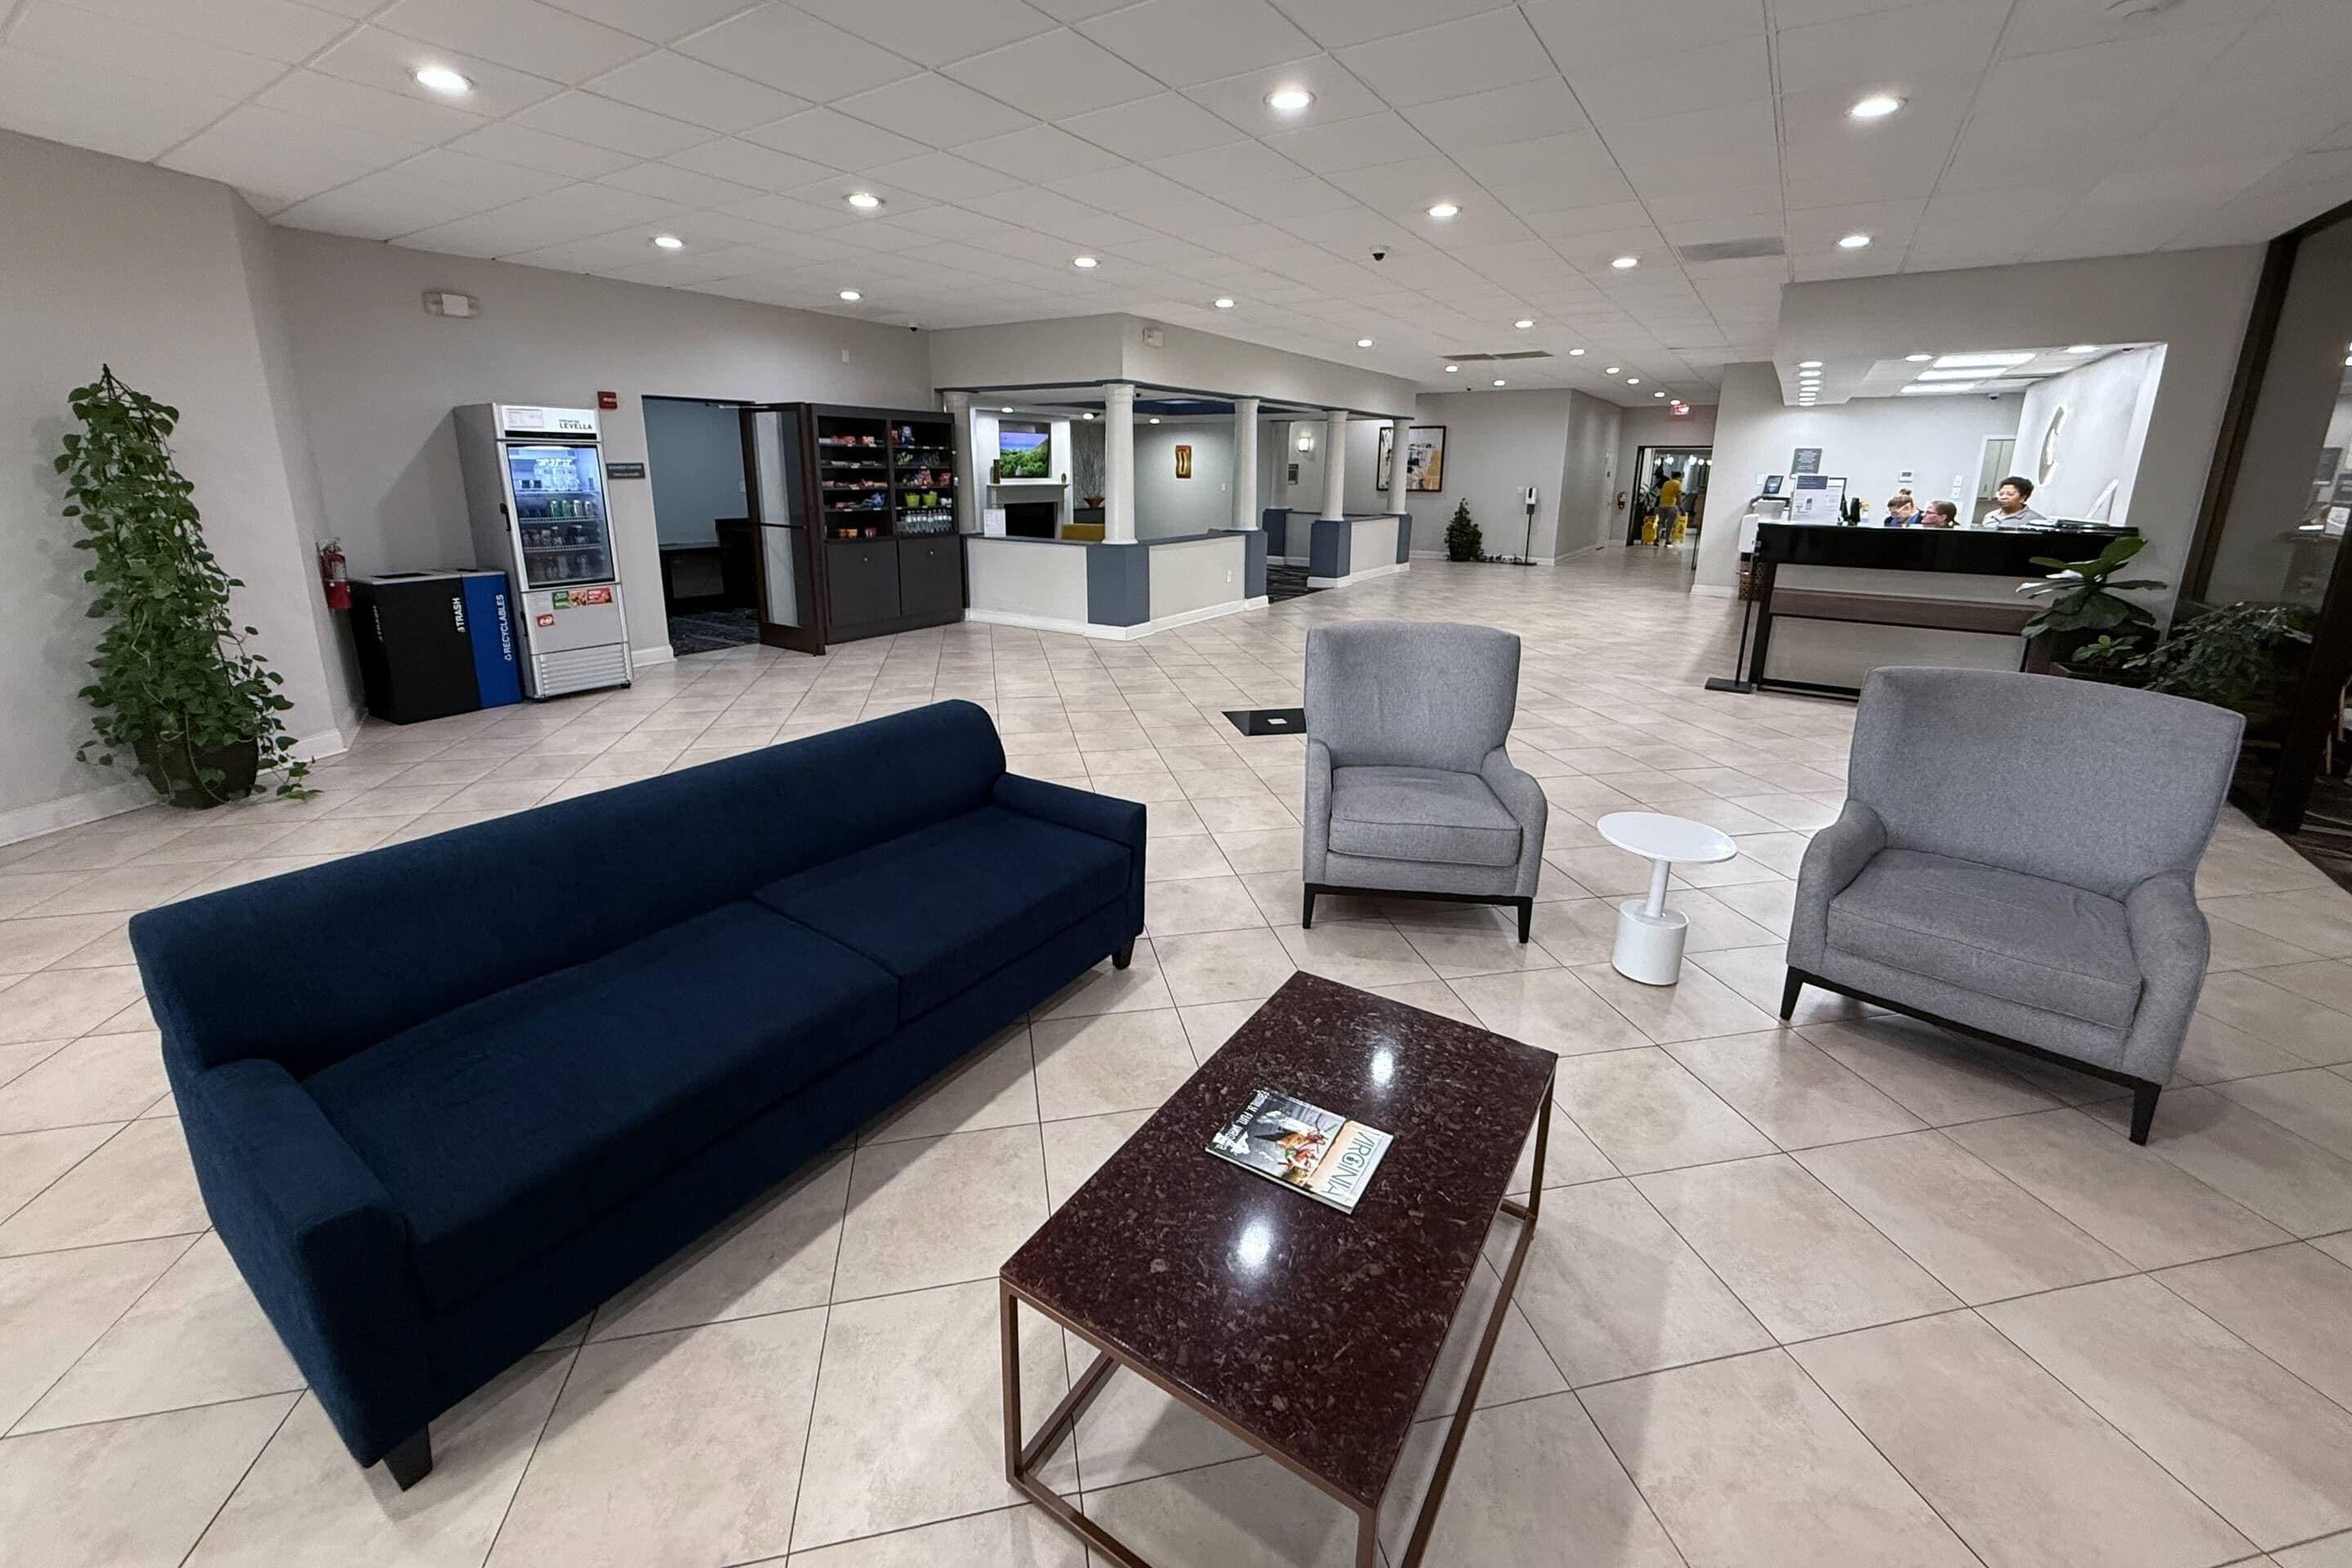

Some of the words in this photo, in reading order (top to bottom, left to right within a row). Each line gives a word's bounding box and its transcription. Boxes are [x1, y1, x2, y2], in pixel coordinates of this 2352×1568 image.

[452, 597, 465, 627] TRASH
[496, 594, 512, 654] RECYCLABLES
[1320, 1131, 1375, 1196] VIRGINIA
